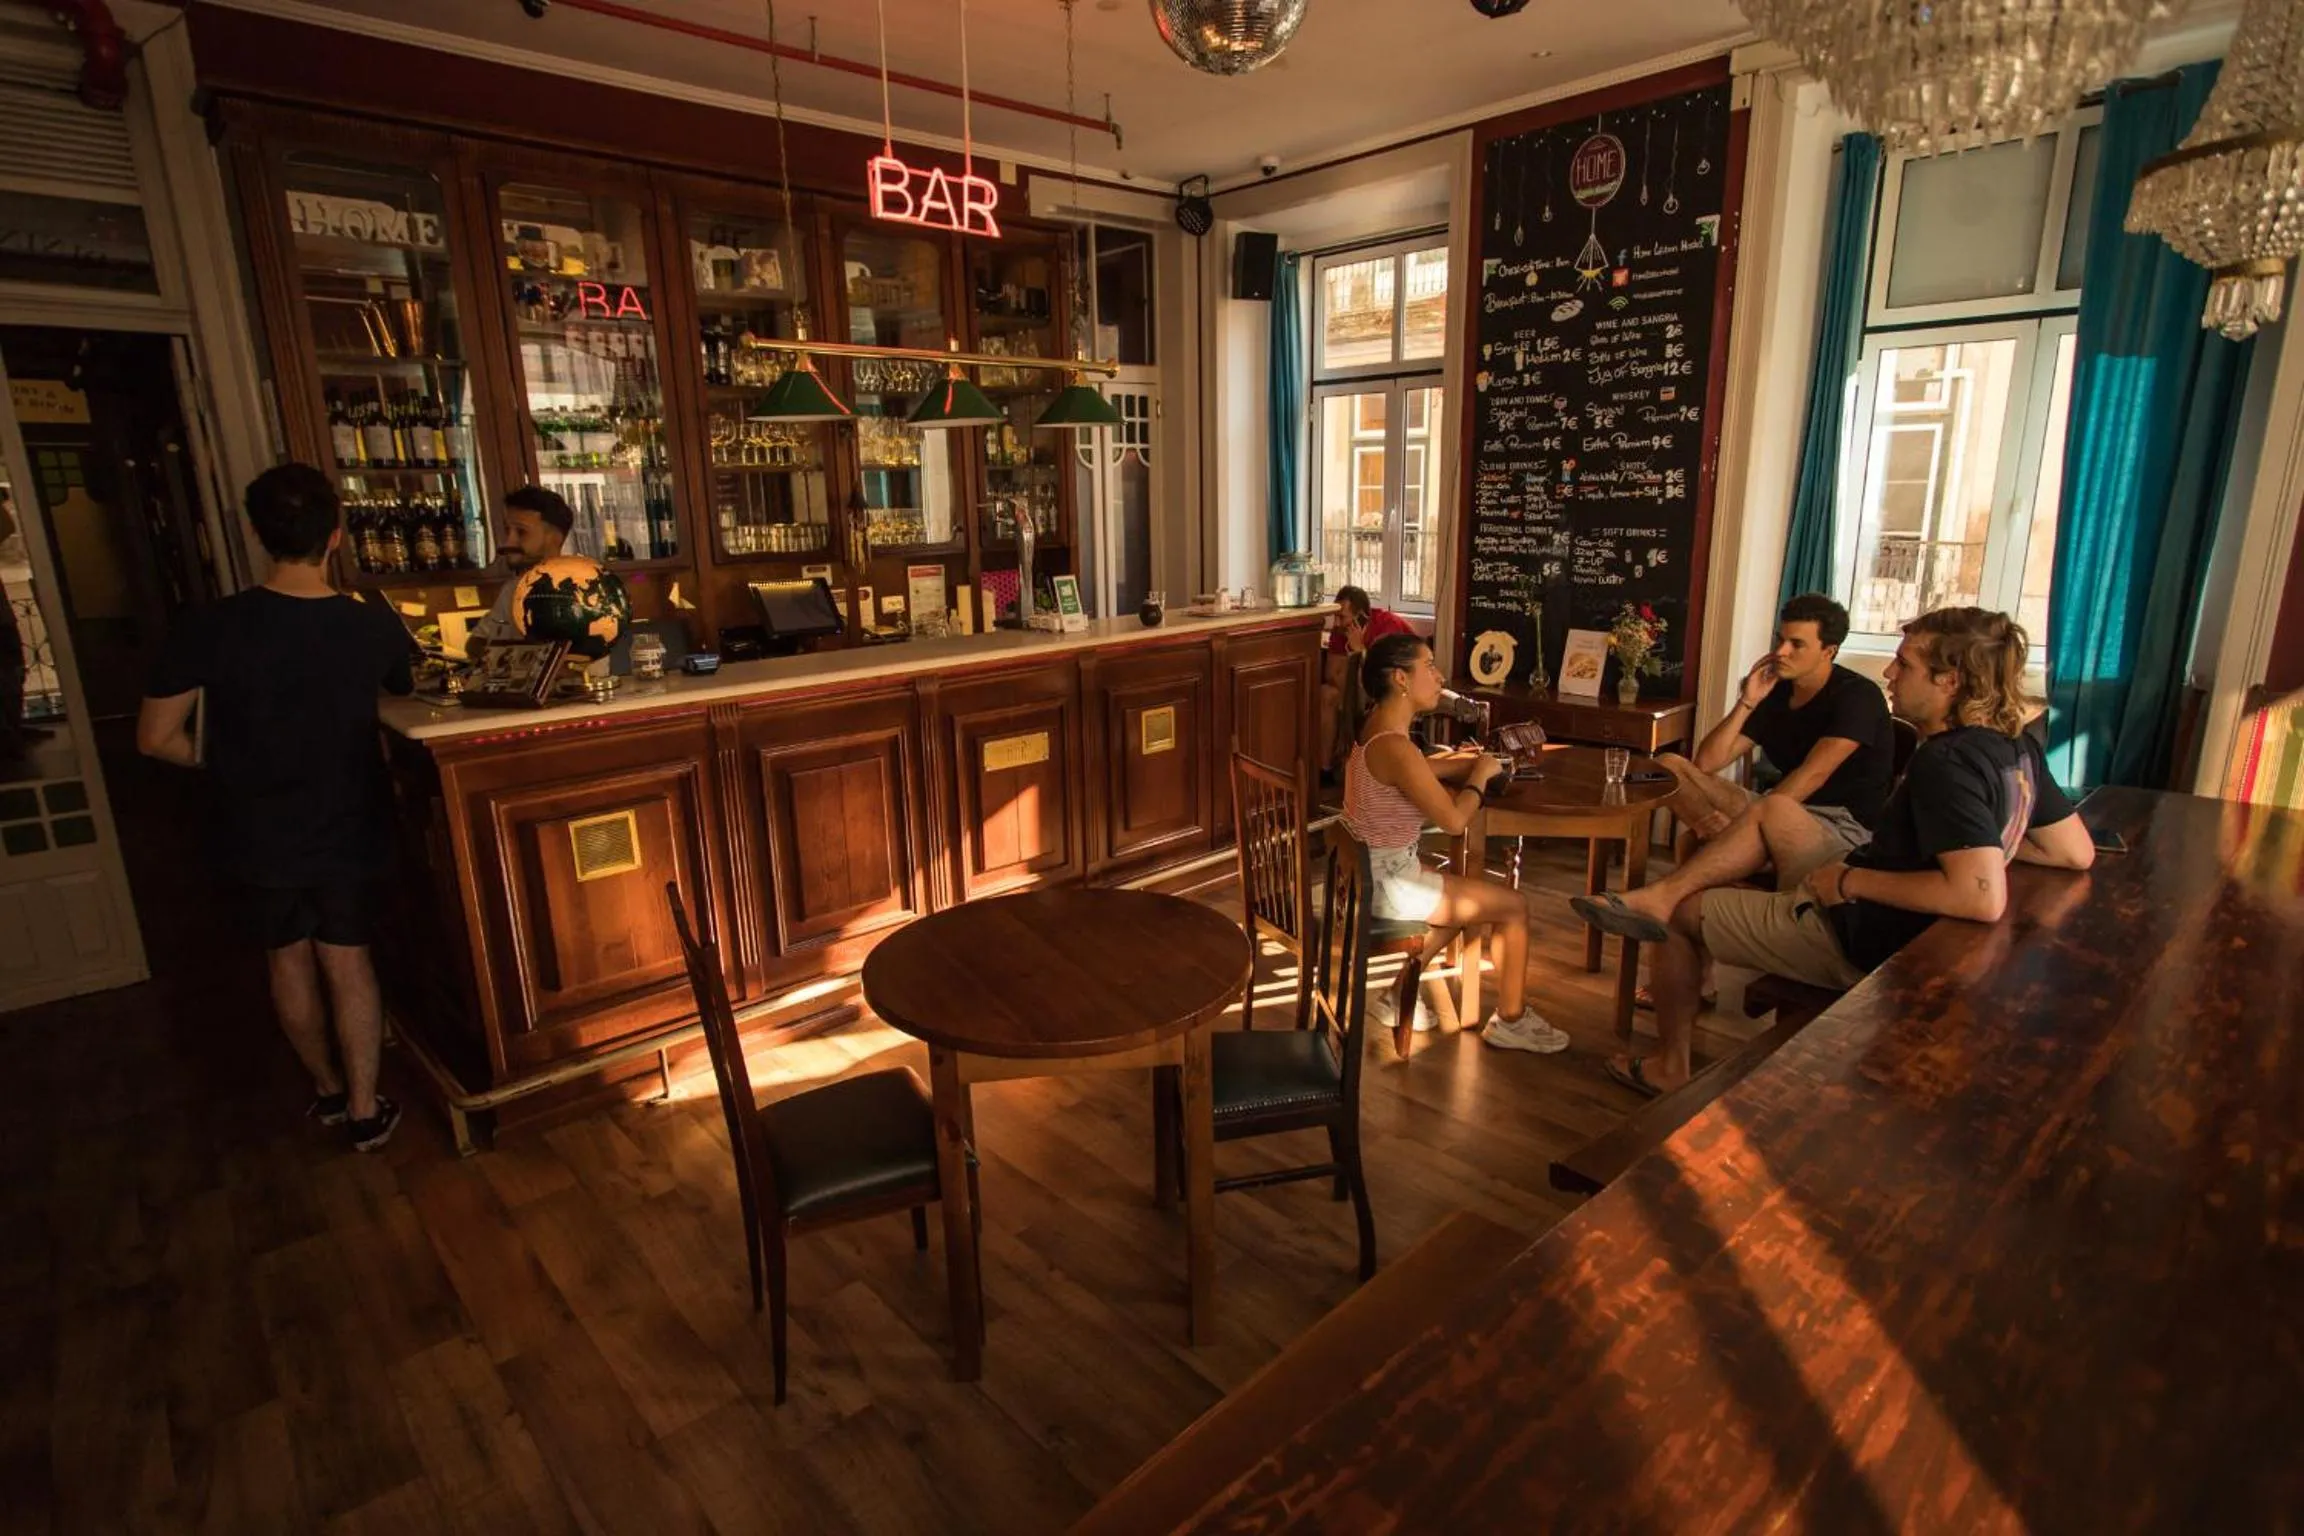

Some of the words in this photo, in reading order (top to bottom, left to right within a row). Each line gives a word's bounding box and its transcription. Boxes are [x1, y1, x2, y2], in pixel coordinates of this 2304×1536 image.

[1576, 150, 1618, 185] HOME
[872, 157, 1001, 238] BAR
[287, 191, 446, 248] HOME
[1595, 319, 1619, 330] WINE
[1621, 317, 1640, 328] AND
[1641, 313, 1679, 325] SANGRIA
[1563, 347, 1583, 363] 2€
[1664, 361, 1693, 376] 12€
[1612, 390, 1651, 401] WHISKEY
[1651, 434, 1674, 451] 9€
[1665, 468, 1685, 484] 2€
[1602, 528, 1625, 537] SOFT
[1626, 528, 1658, 538] DRINKS
